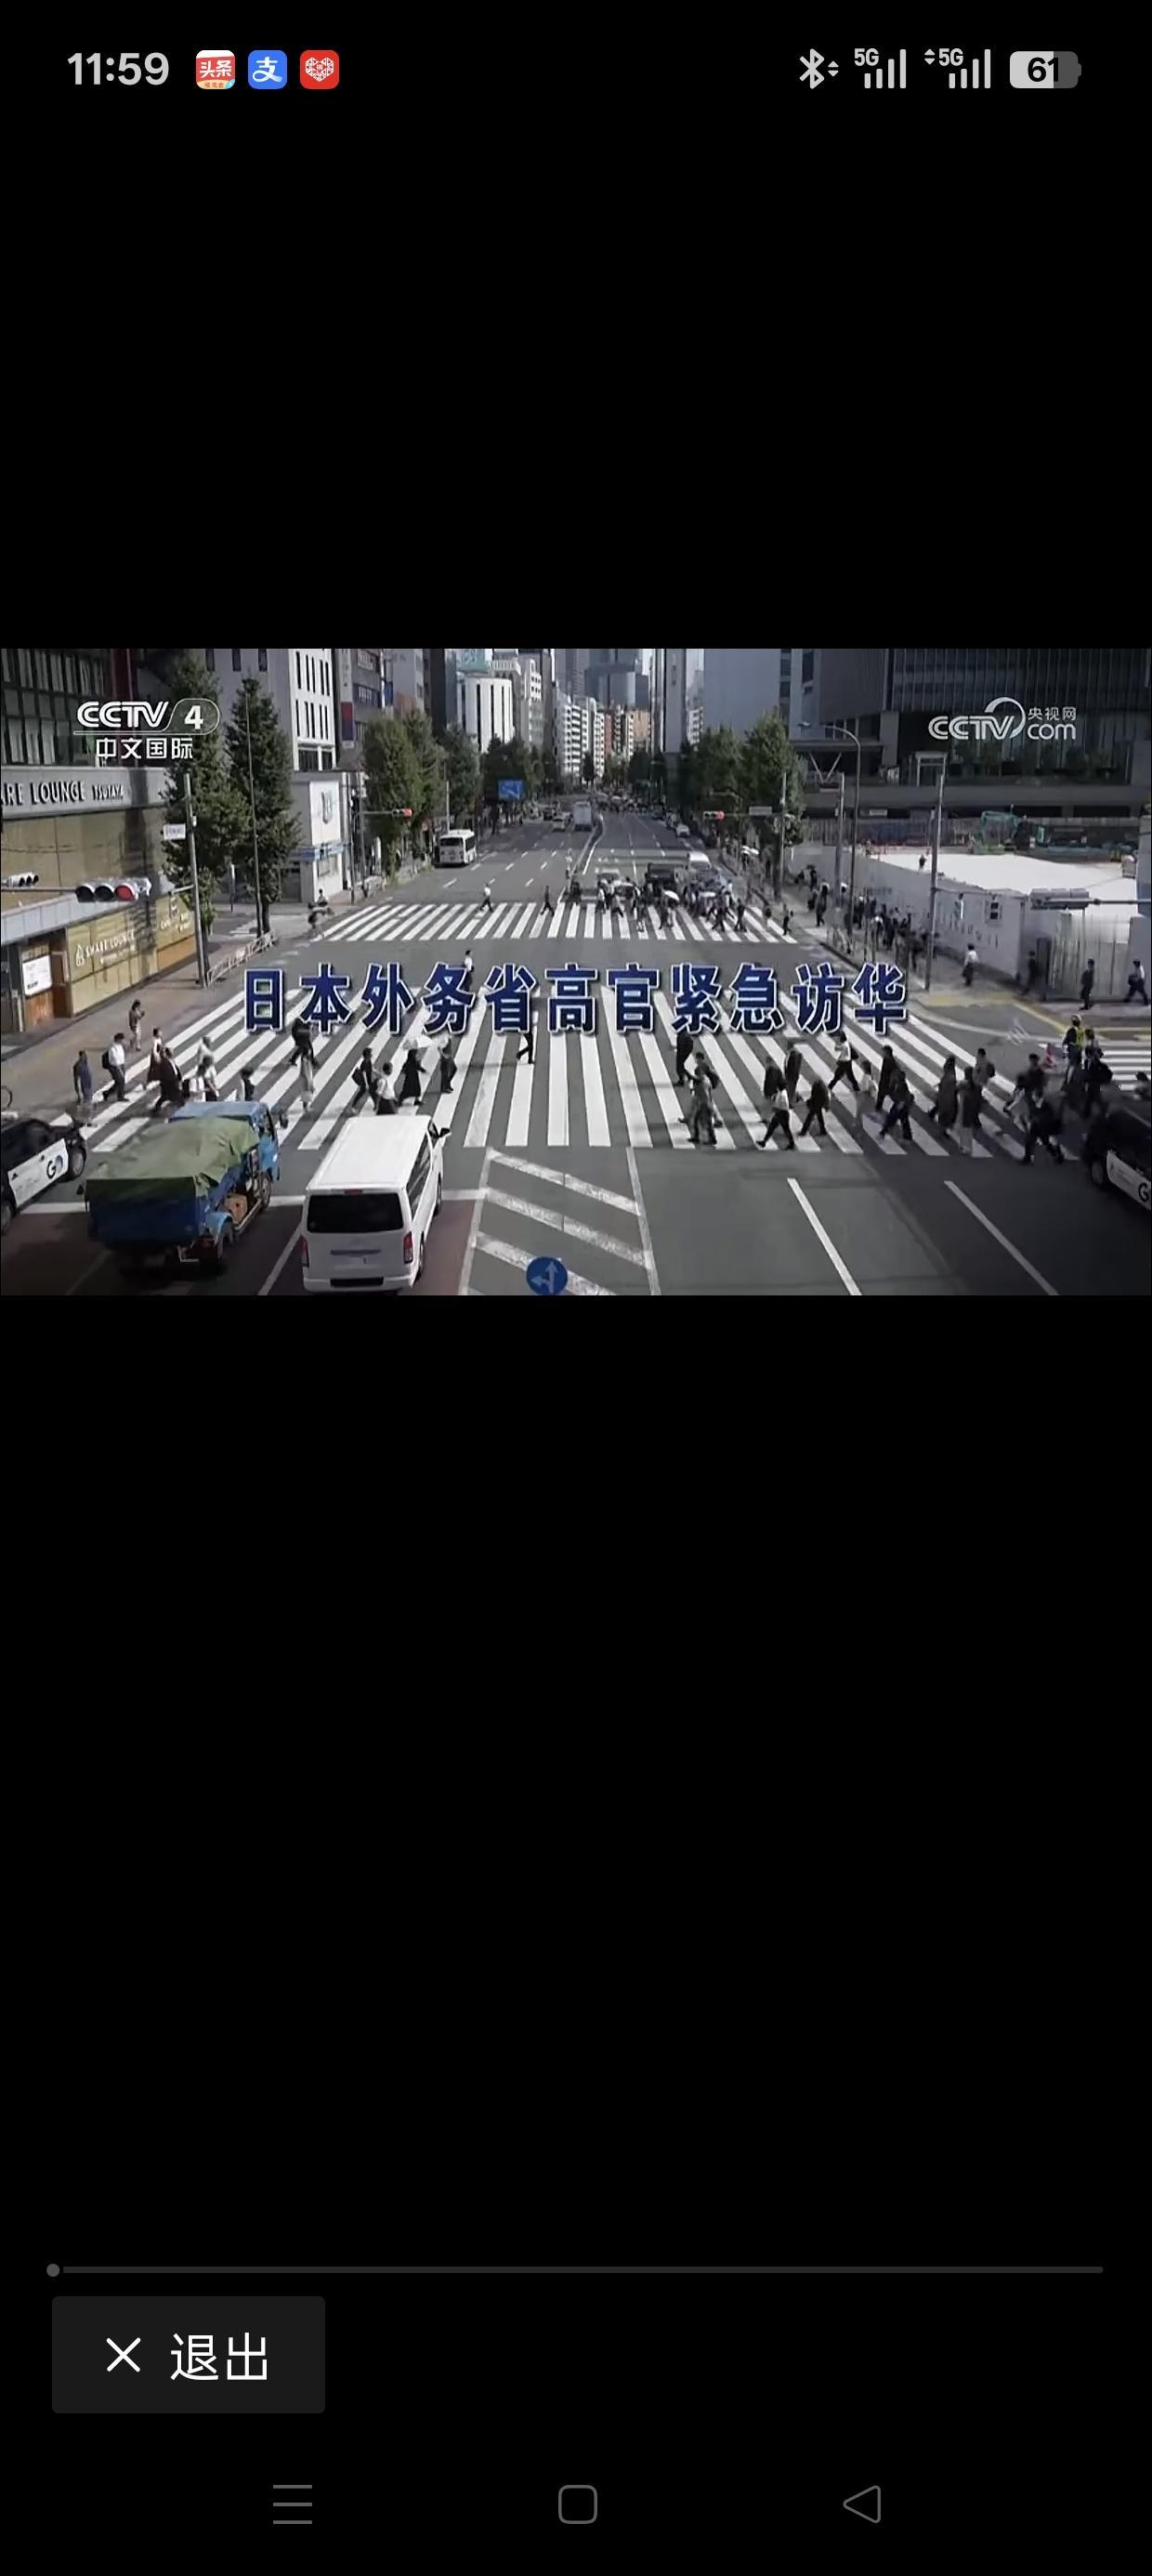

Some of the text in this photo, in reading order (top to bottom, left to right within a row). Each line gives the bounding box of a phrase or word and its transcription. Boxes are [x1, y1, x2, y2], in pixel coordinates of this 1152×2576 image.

[67, 52, 169, 85] 11:59
[199, 59, 232, 78] 头条
[854, 47, 880, 66] 5G
[938, 47, 964, 66] 5G
[1028, 57, 1059, 82] 61
[1, 782, 22, 806] RE
[30, 781, 85, 805] LOUNGE
[171, 2332, 268, 2381] 退出
